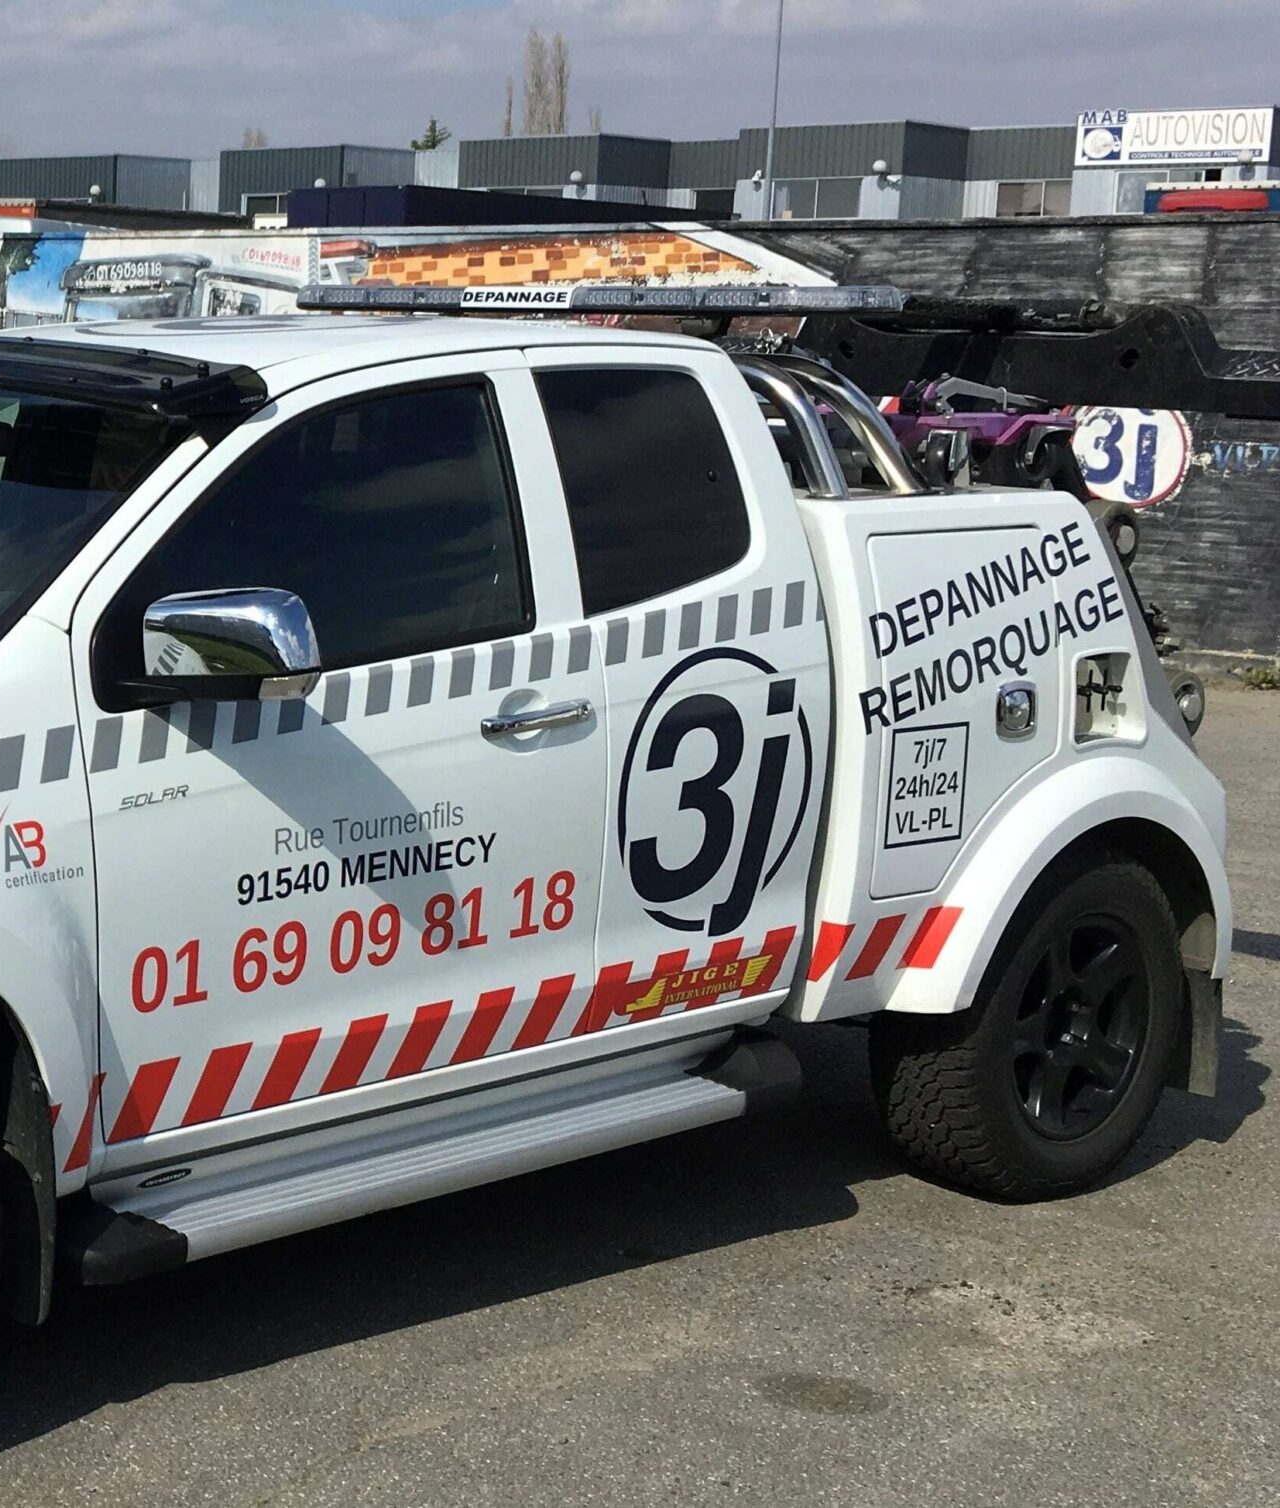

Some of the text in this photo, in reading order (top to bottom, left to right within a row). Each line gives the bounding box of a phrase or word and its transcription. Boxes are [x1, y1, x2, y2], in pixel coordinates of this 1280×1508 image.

[1082, 109, 1128, 125] MAB
[1130, 112, 1267, 147] AUTOVISION
[462, 291, 568, 303] DEPANNAGE
[868, 521, 1091, 660] DEPANNAGE
[858, 576, 1124, 736] REMORQUAGE
[913, 738, 948, 769] 7j/7
[118, 784, 190, 811] SOLAR
[894, 771, 959, 801] 24h/24
[628, 677, 797, 938] 3j
[895, 806, 954, 835] VL-PL
[274, 801, 465, 855] Rue Tournenfils
[4, 820, 47, 873] AB
[5, 864, 84, 889] certification
[236, 832, 497, 906] 91540 MENNECY
[131, 869, 577, 1013] 01 69 09 81 18
[672, 962, 740, 988] JIGE
[664, 979, 738, 1004] INTERNATIONAL
